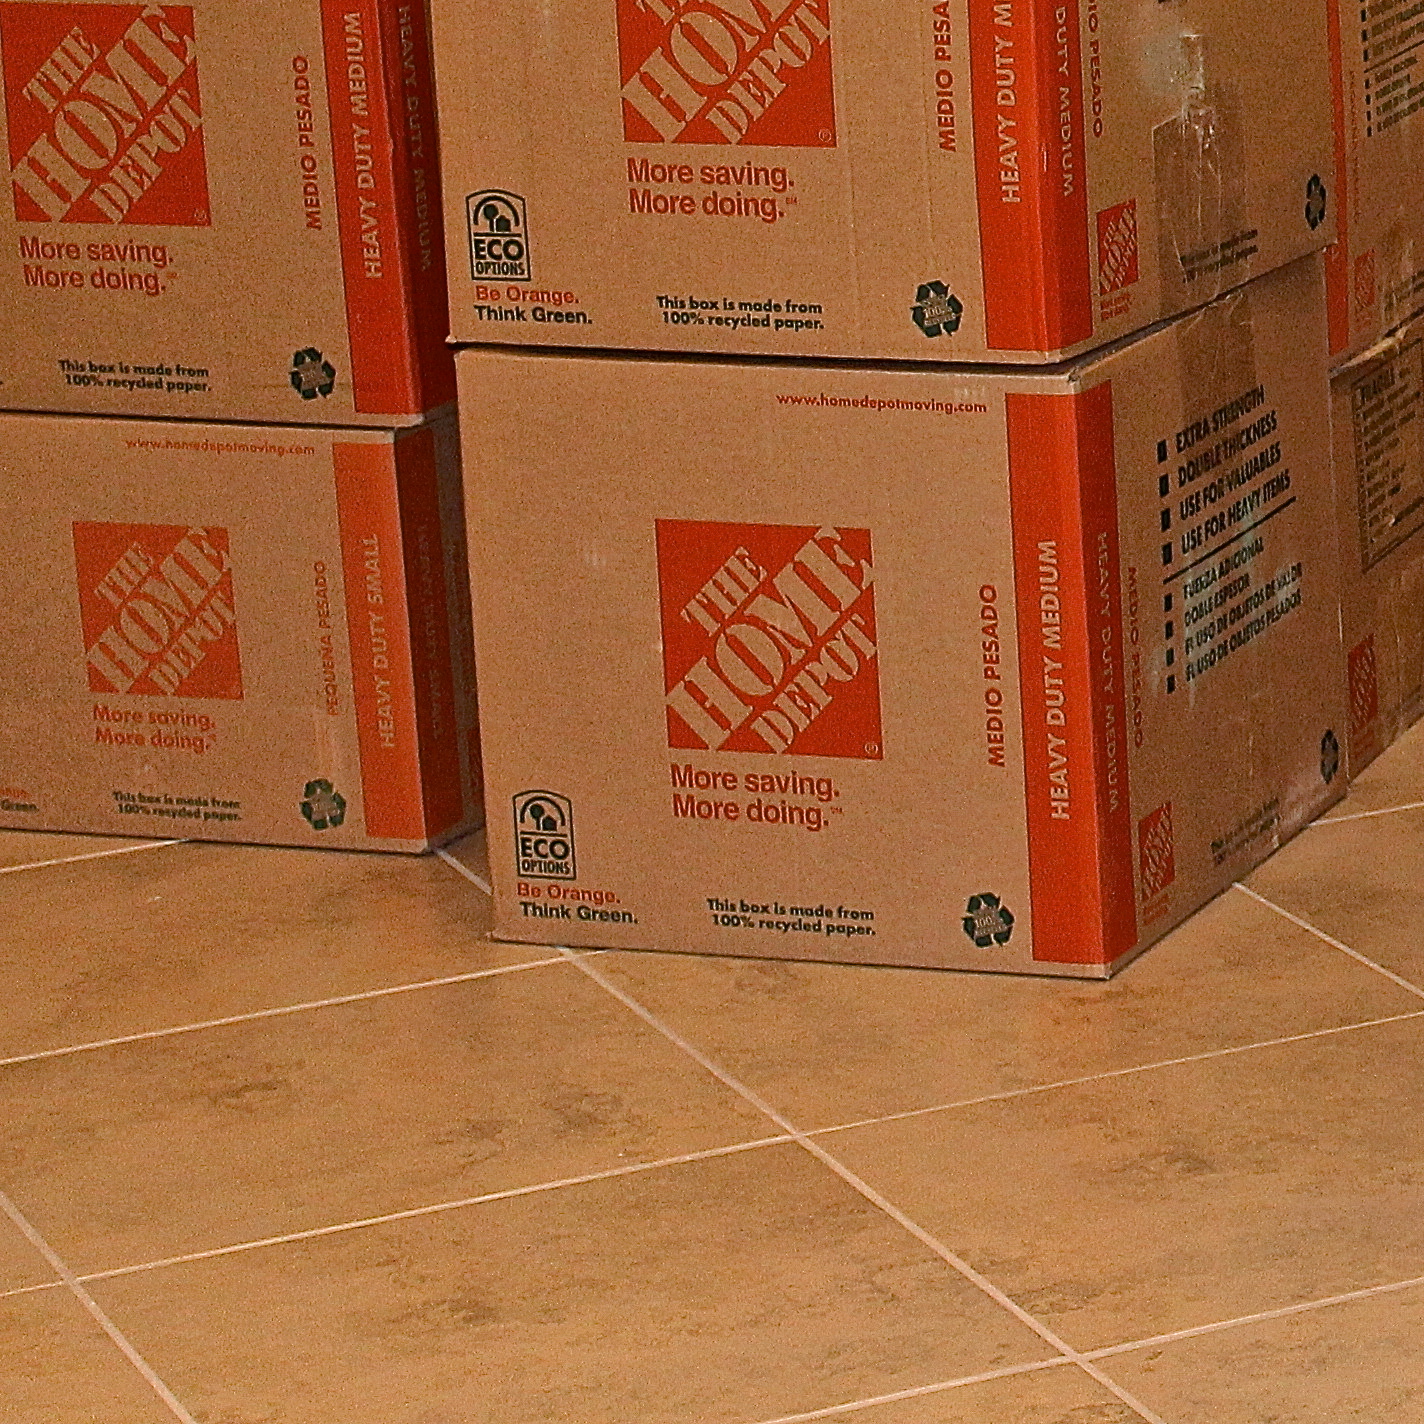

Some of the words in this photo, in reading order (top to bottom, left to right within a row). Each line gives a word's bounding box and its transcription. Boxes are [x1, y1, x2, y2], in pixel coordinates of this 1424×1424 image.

[24, 26, 100, 113] THE
[344, 12, 370, 118] MEDIUM
[993, 35, 1018, 109] DUTY
[12, 4, 197, 221] HOME
[293, 55, 315, 147] PESADO
[934, 65, 958, 153] MEDIO
[90, 89, 201, 224] DEPOT
[352, 123, 376, 191] DUTY
[627, 158, 695, 185] More
[700, 161, 793, 192] saving.
[997, 112, 1022, 205] HEAVY
[301, 153, 322, 230] MEDIO
[629, 188, 696, 215] More
[702, 193, 784, 223] doing.
[20, 236, 80, 264] More
[87, 240, 173, 270] saving.
[358, 196, 383, 279] HEAVY
[474, 239, 524, 261] ECO
[475, 261, 526, 276] OPTIONS
[24, 264, 84, 287] More
[91, 266, 166, 295] doing.
[476, 286, 500, 302] Be
[506, 287, 580, 307] Orange.
[656, 295, 685, 311] This
[688, 297, 719, 313] box
[722, 298, 736, 313] is
[738, 298, 782, 314] made
[785, 299, 823, 314] from
[475, 305, 527, 323] Think
[532, 307, 593, 325] Green.
[662, 311, 704, 327] 100%
[707, 312, 770, 331] recycled
[774, 315, 824, 332] paper.
[776, 392, 987, 414] www.homedepotmoving.com
[362, 534, 384, 606] SMALL
[681, 546, 767, 636] THE
[1037, 539, 1063, 650] MEDIUM
[369, 610, 390, 670] DUTY
[667, 527, 874, 751] HOME
[979, 584, 1002, 683] PESADO
[374, 676, 397, 748] HEAVY
[751, 614, 878, 753] DEPOT
[1043, 657, 1067, 728] DUTY
[983, 691, 1006, 768] MEDIO
[671, 763, 738, 790] More
[745, 769, 840, 799] saving.
[1045, 733, 1070, 821] HEAVY
[673, 794, 739, 821] More
[746, 799, 830, 831] doing.
[521, 838, 570, 859] ECO
[522, 858, 570, 875] OPTIONS
[517, 881, 541, 899] Be
[547, 883, 621, 905] Orange.
[519, 901, 571, 919] Think
[577, 903, 639, 925] Green.
[706, 897, 736, 914] This
[740, 899, 770, 916] box
[774, 900, 785, 916] is
[790, 901, 832, 918] made
[836, 903, 874, 920] from
[712, 913, 754, 930] 100%
[758, 915, 822, 934] recycled
[826, 918, 876, 936] paper.
